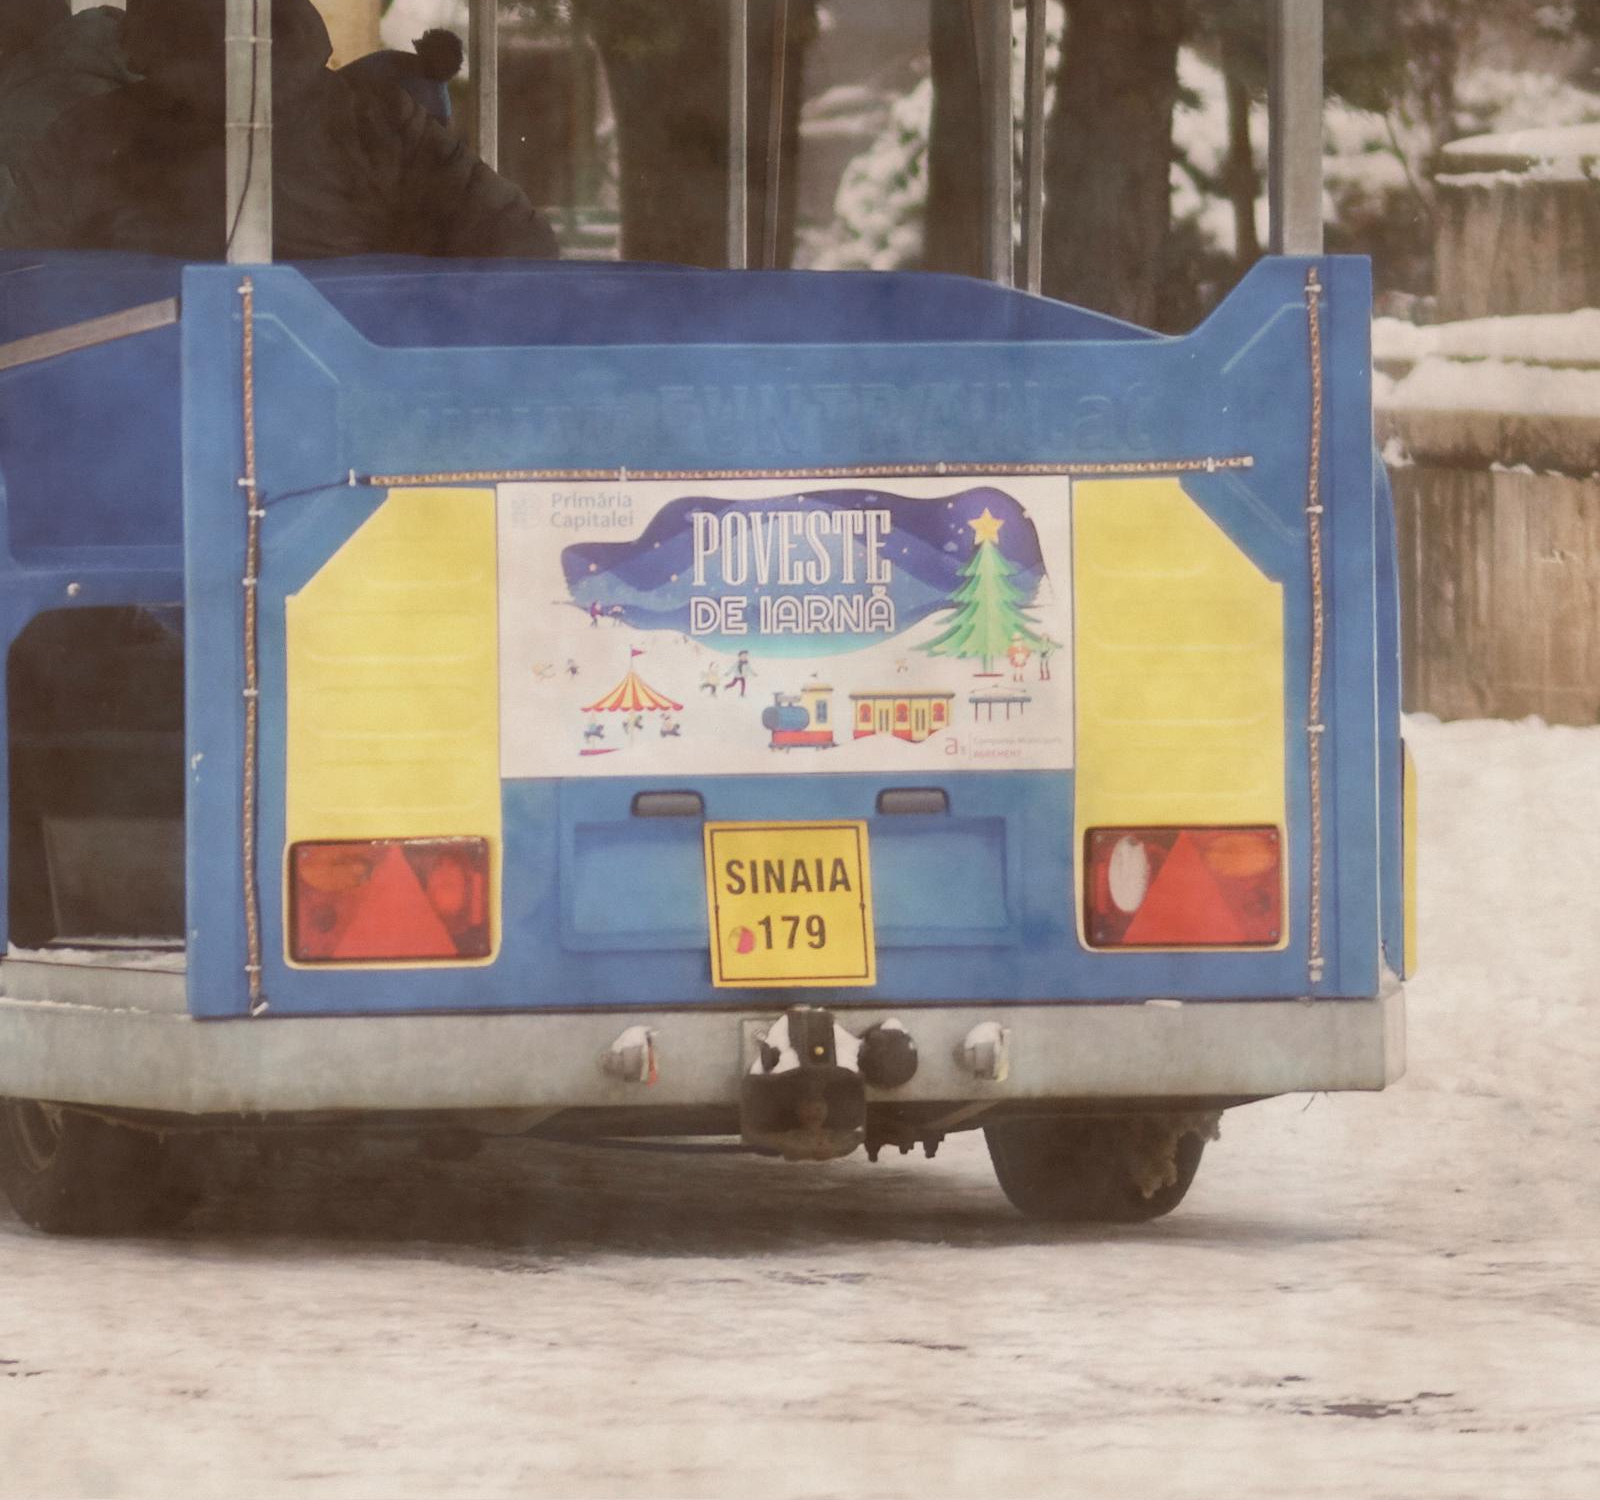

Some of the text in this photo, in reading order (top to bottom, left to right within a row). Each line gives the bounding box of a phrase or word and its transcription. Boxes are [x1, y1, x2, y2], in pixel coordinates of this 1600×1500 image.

[551, 491, 633, 509] Primăria
[550, 510, 634, 531] Capitalei
[691, 509, 892, 587] POVESTE
[690, 586, 896, 636] DE IARNĂ
[725, 857, 852, 895] SINAIA
[757, 914, 827, 950] 179
